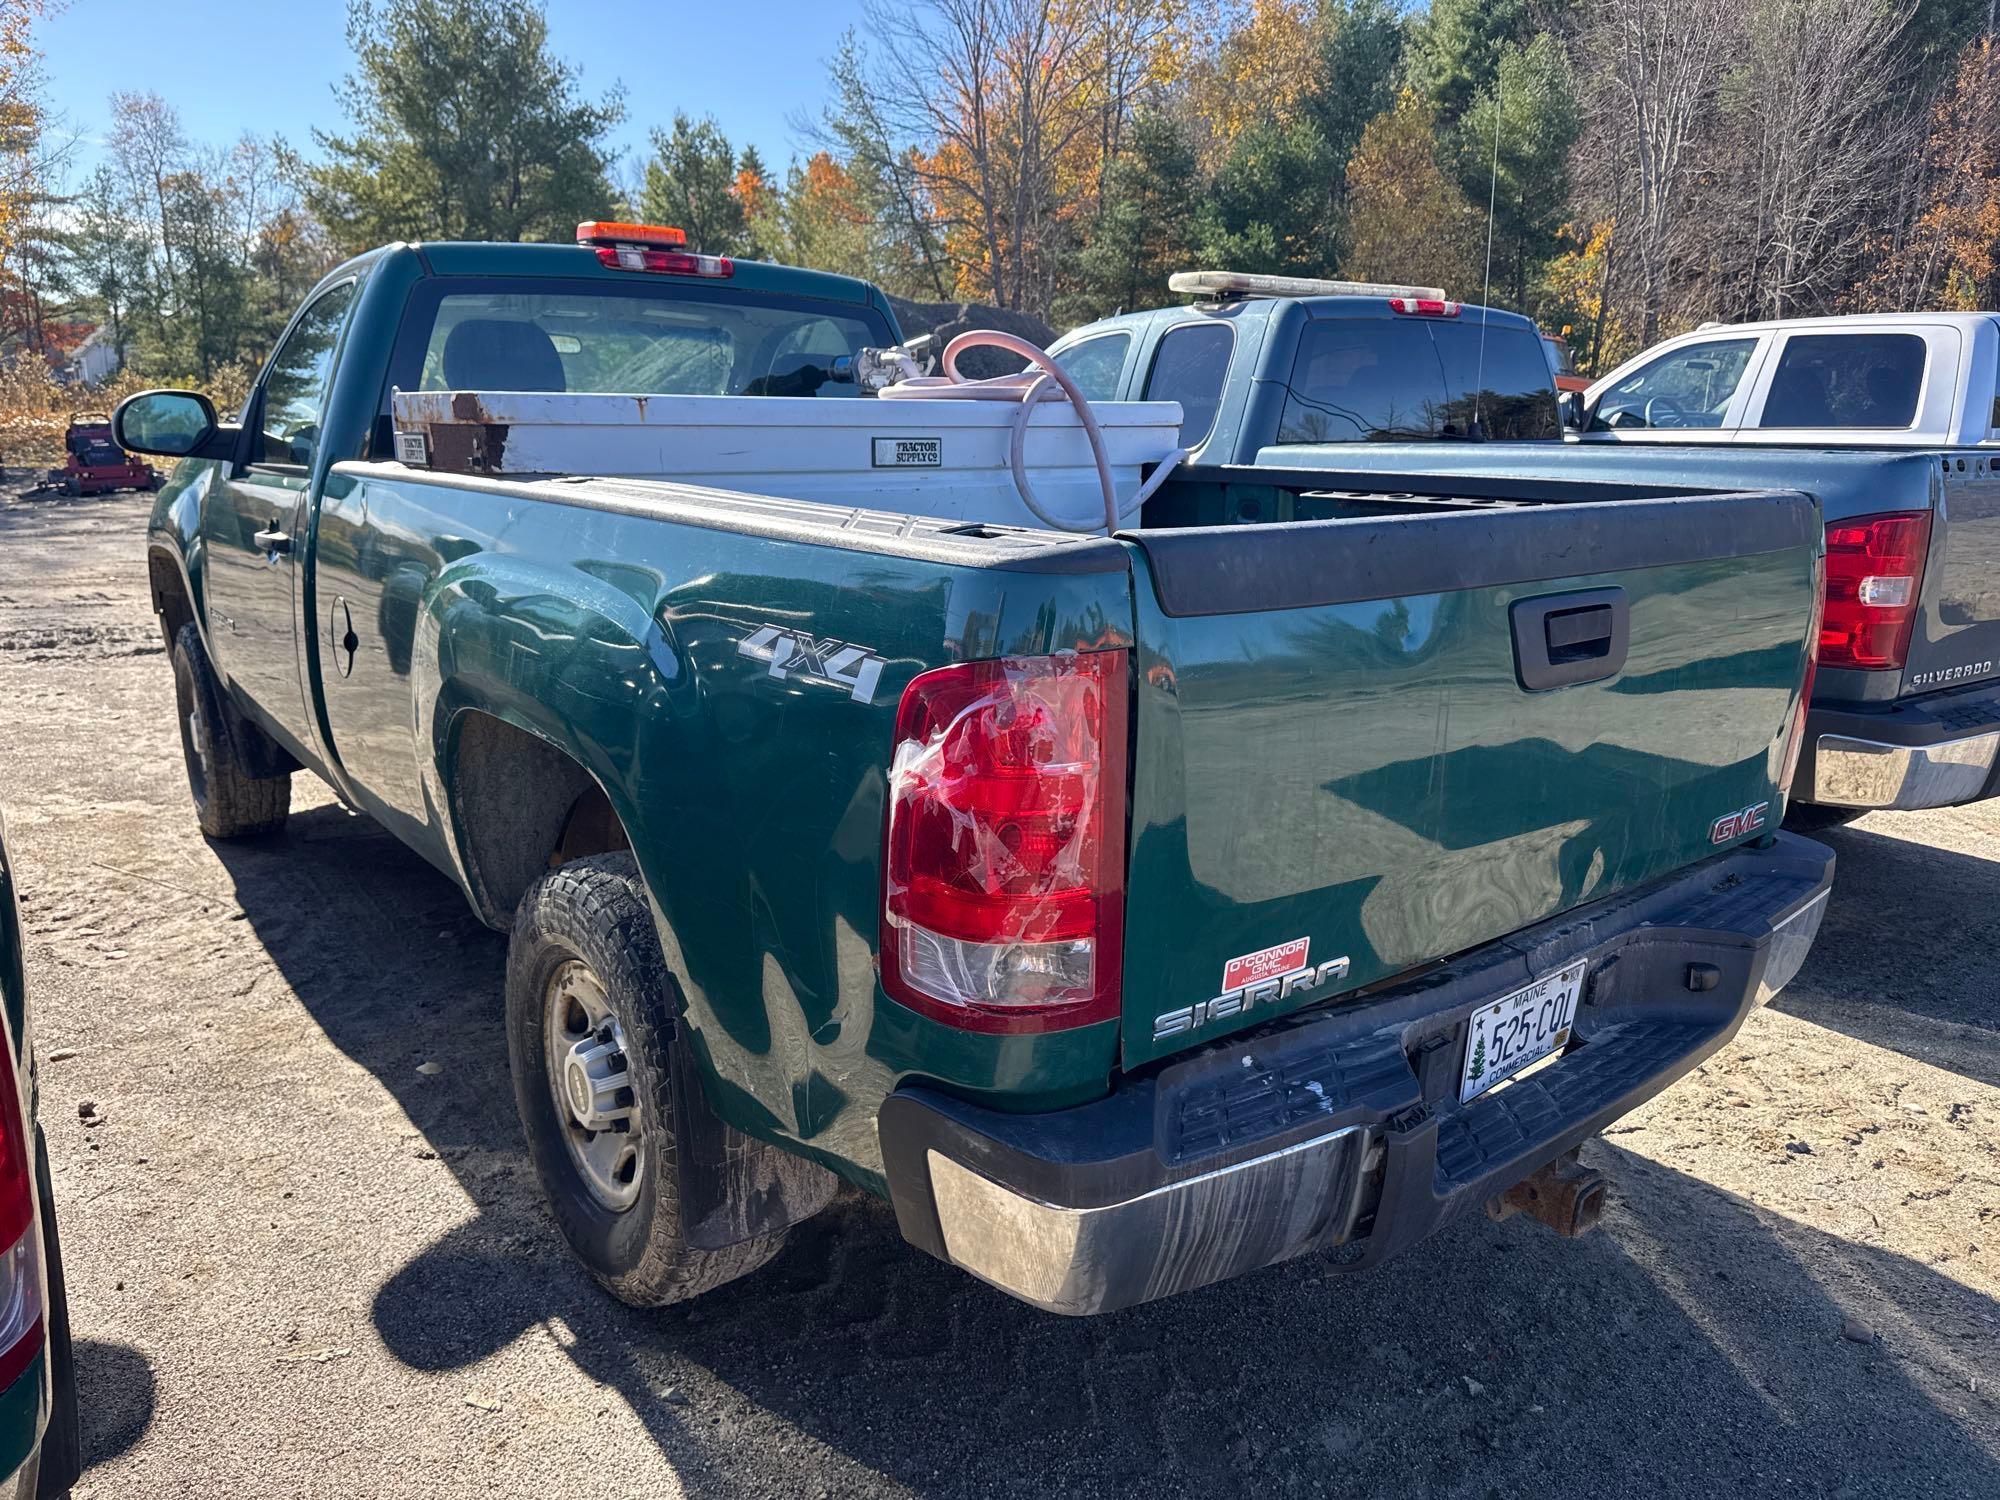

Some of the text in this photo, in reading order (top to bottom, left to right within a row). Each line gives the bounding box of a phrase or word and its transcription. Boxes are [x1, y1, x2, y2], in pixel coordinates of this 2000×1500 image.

[896, 442, 937, 452] TRACTOR
[896, 452, 926, 463] SUPPLY
[1912, 660, 1992, 687] SILVERADO
[1711, 801, 1769, 845] GMC
[1229, 941, 1306, 973] O'CONNOR
[1252, 957, 1282, 975] GMC
[1270, 963, 1291, 975] MAINE
[1152, 955, 1350, 1042] SIERRA
[1512, 982, 1548, 1009] MAINE
[1489, 1045, 1546, 1083] COMMERCIAL
